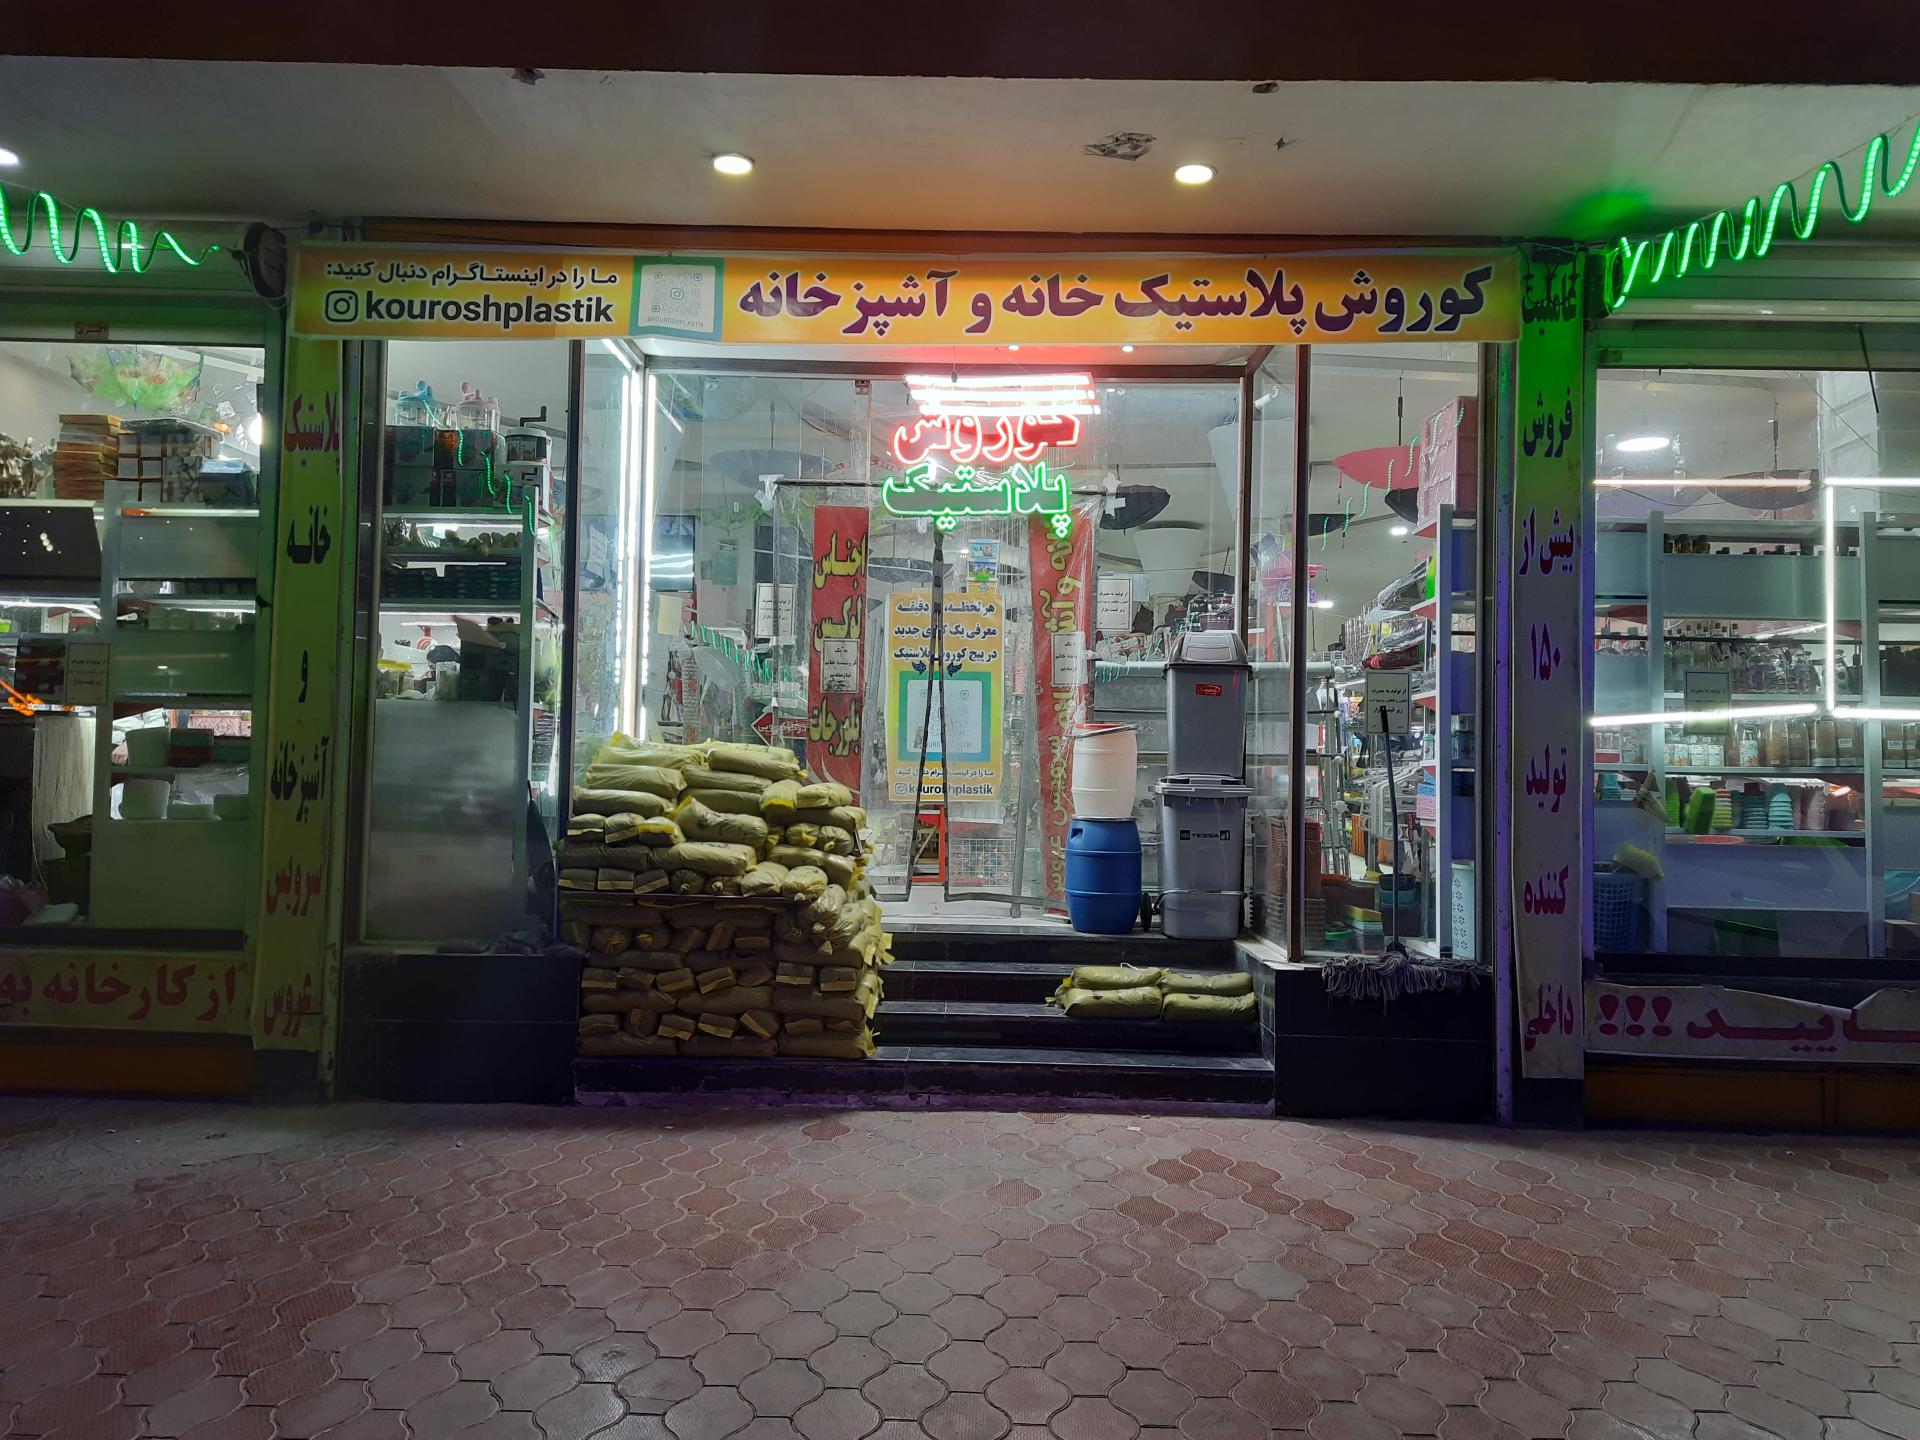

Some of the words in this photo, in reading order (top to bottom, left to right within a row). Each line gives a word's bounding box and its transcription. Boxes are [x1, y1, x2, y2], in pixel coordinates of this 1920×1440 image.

[326, 260, 374, 280] کنید:
[378, 262, 427, 283] دنبال
[431, 263, 544, 287] اینستاگرام
[547, 269, 567, 289] در
[573, 268, 585, 289] را
[589, 269, 618, 284] ما
[1001, 273, 1105, 318] خانه
[1314, 265, 1493, 333] کوروش
[366, 290, 613, 329] kouroshplastik
[739, 270, 958, 337] آشپزخانه
[964, 291, 992, 334] و
[1114, 267, 1307, 335] پلاستیک
[284, 391, 341, 475] پلاستیک
[1523, 385, 1573, 458] فروش
[881, 461, 1072, 539] پلاستیک
[287, 505, 331, 564] خانه
[813, 531, 867, 590] اجناس
[1519, 508, 1536, 576] از
[1540, 509, 1574, 575] بیش
[894, 625, 920, 638] جدید
[897, 600, 929, 614] دقیقه
[966, 625, 998, 639] معرفی
[298, 650, 309, 703] و
[939, 647, 968, 662] کورو
[985, 649, 998, 662] در
[809, 697, 861, 757] بلورجات
[270, 736, 330, 824] آشپزخانه
[1525, 743, 1568, 813] تولید
[266, 855, 322, 917] سرویس
[1524, 864, 1569, 915] کننده
[42, 960, 197, 1020] کارخانه
[196, 964, 237, 1022] از
[263, 973, 312, 1038] عروس
[1524, 983, 1574, 1052] داخلی
